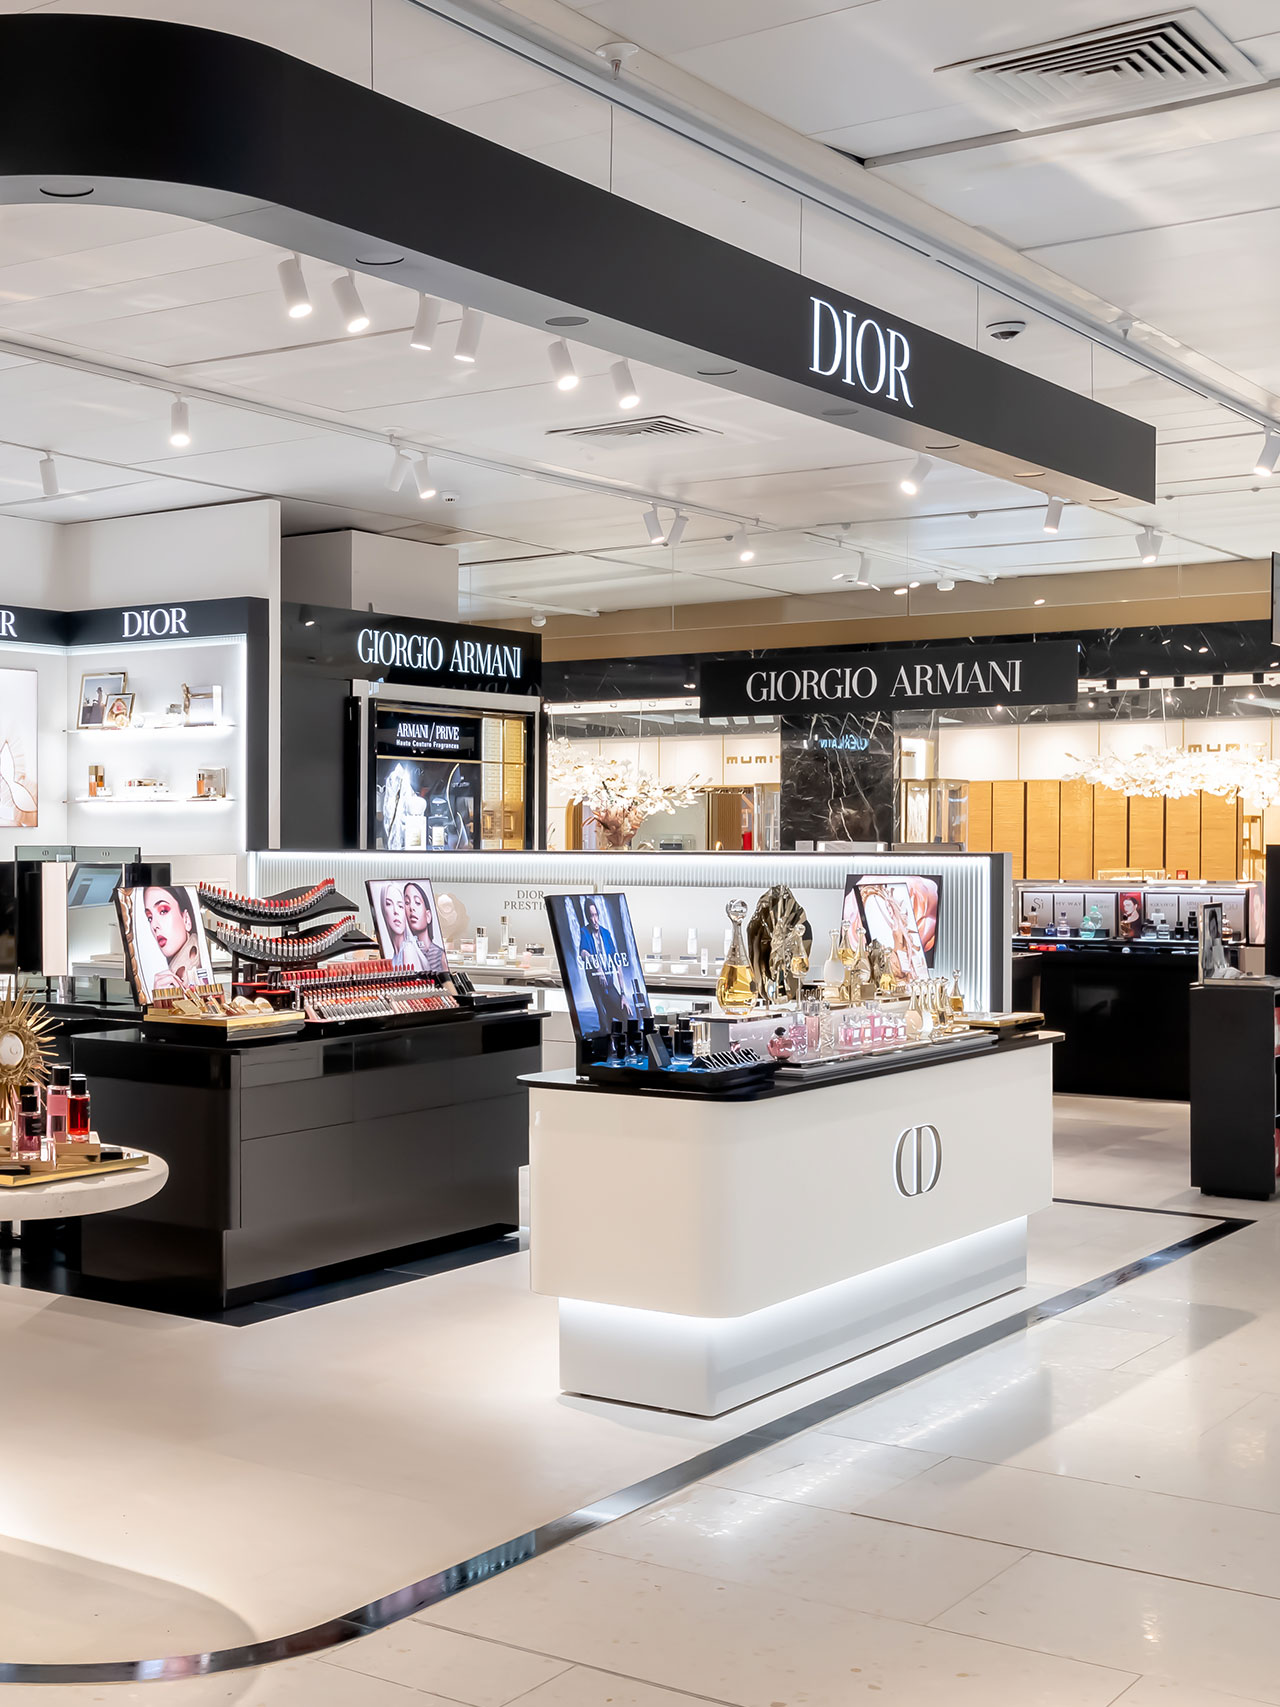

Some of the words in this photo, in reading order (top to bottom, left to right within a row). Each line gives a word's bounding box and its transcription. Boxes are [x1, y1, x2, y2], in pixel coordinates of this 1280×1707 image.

[809, 297, 913, 408] DIOR
[121, 607, 190, 638] DIOR
[357, 628, 444, 671] GIORGIO
[448, 639, 522, 679] ARMANI
[746, 667, 878, 703] GIORGIO
[889, 659, 1023, 697] ARMANI
[396, 739, 411, 747] Haute
[412, 740, 432, 748] Couture
[433, 741, 459, 750] Fragrances
[516, 889, 545, 900] DIOR
[576, 952, 630, 972] SAUVAGE
[702, 1047, 762, 1070] SAUVAGE
